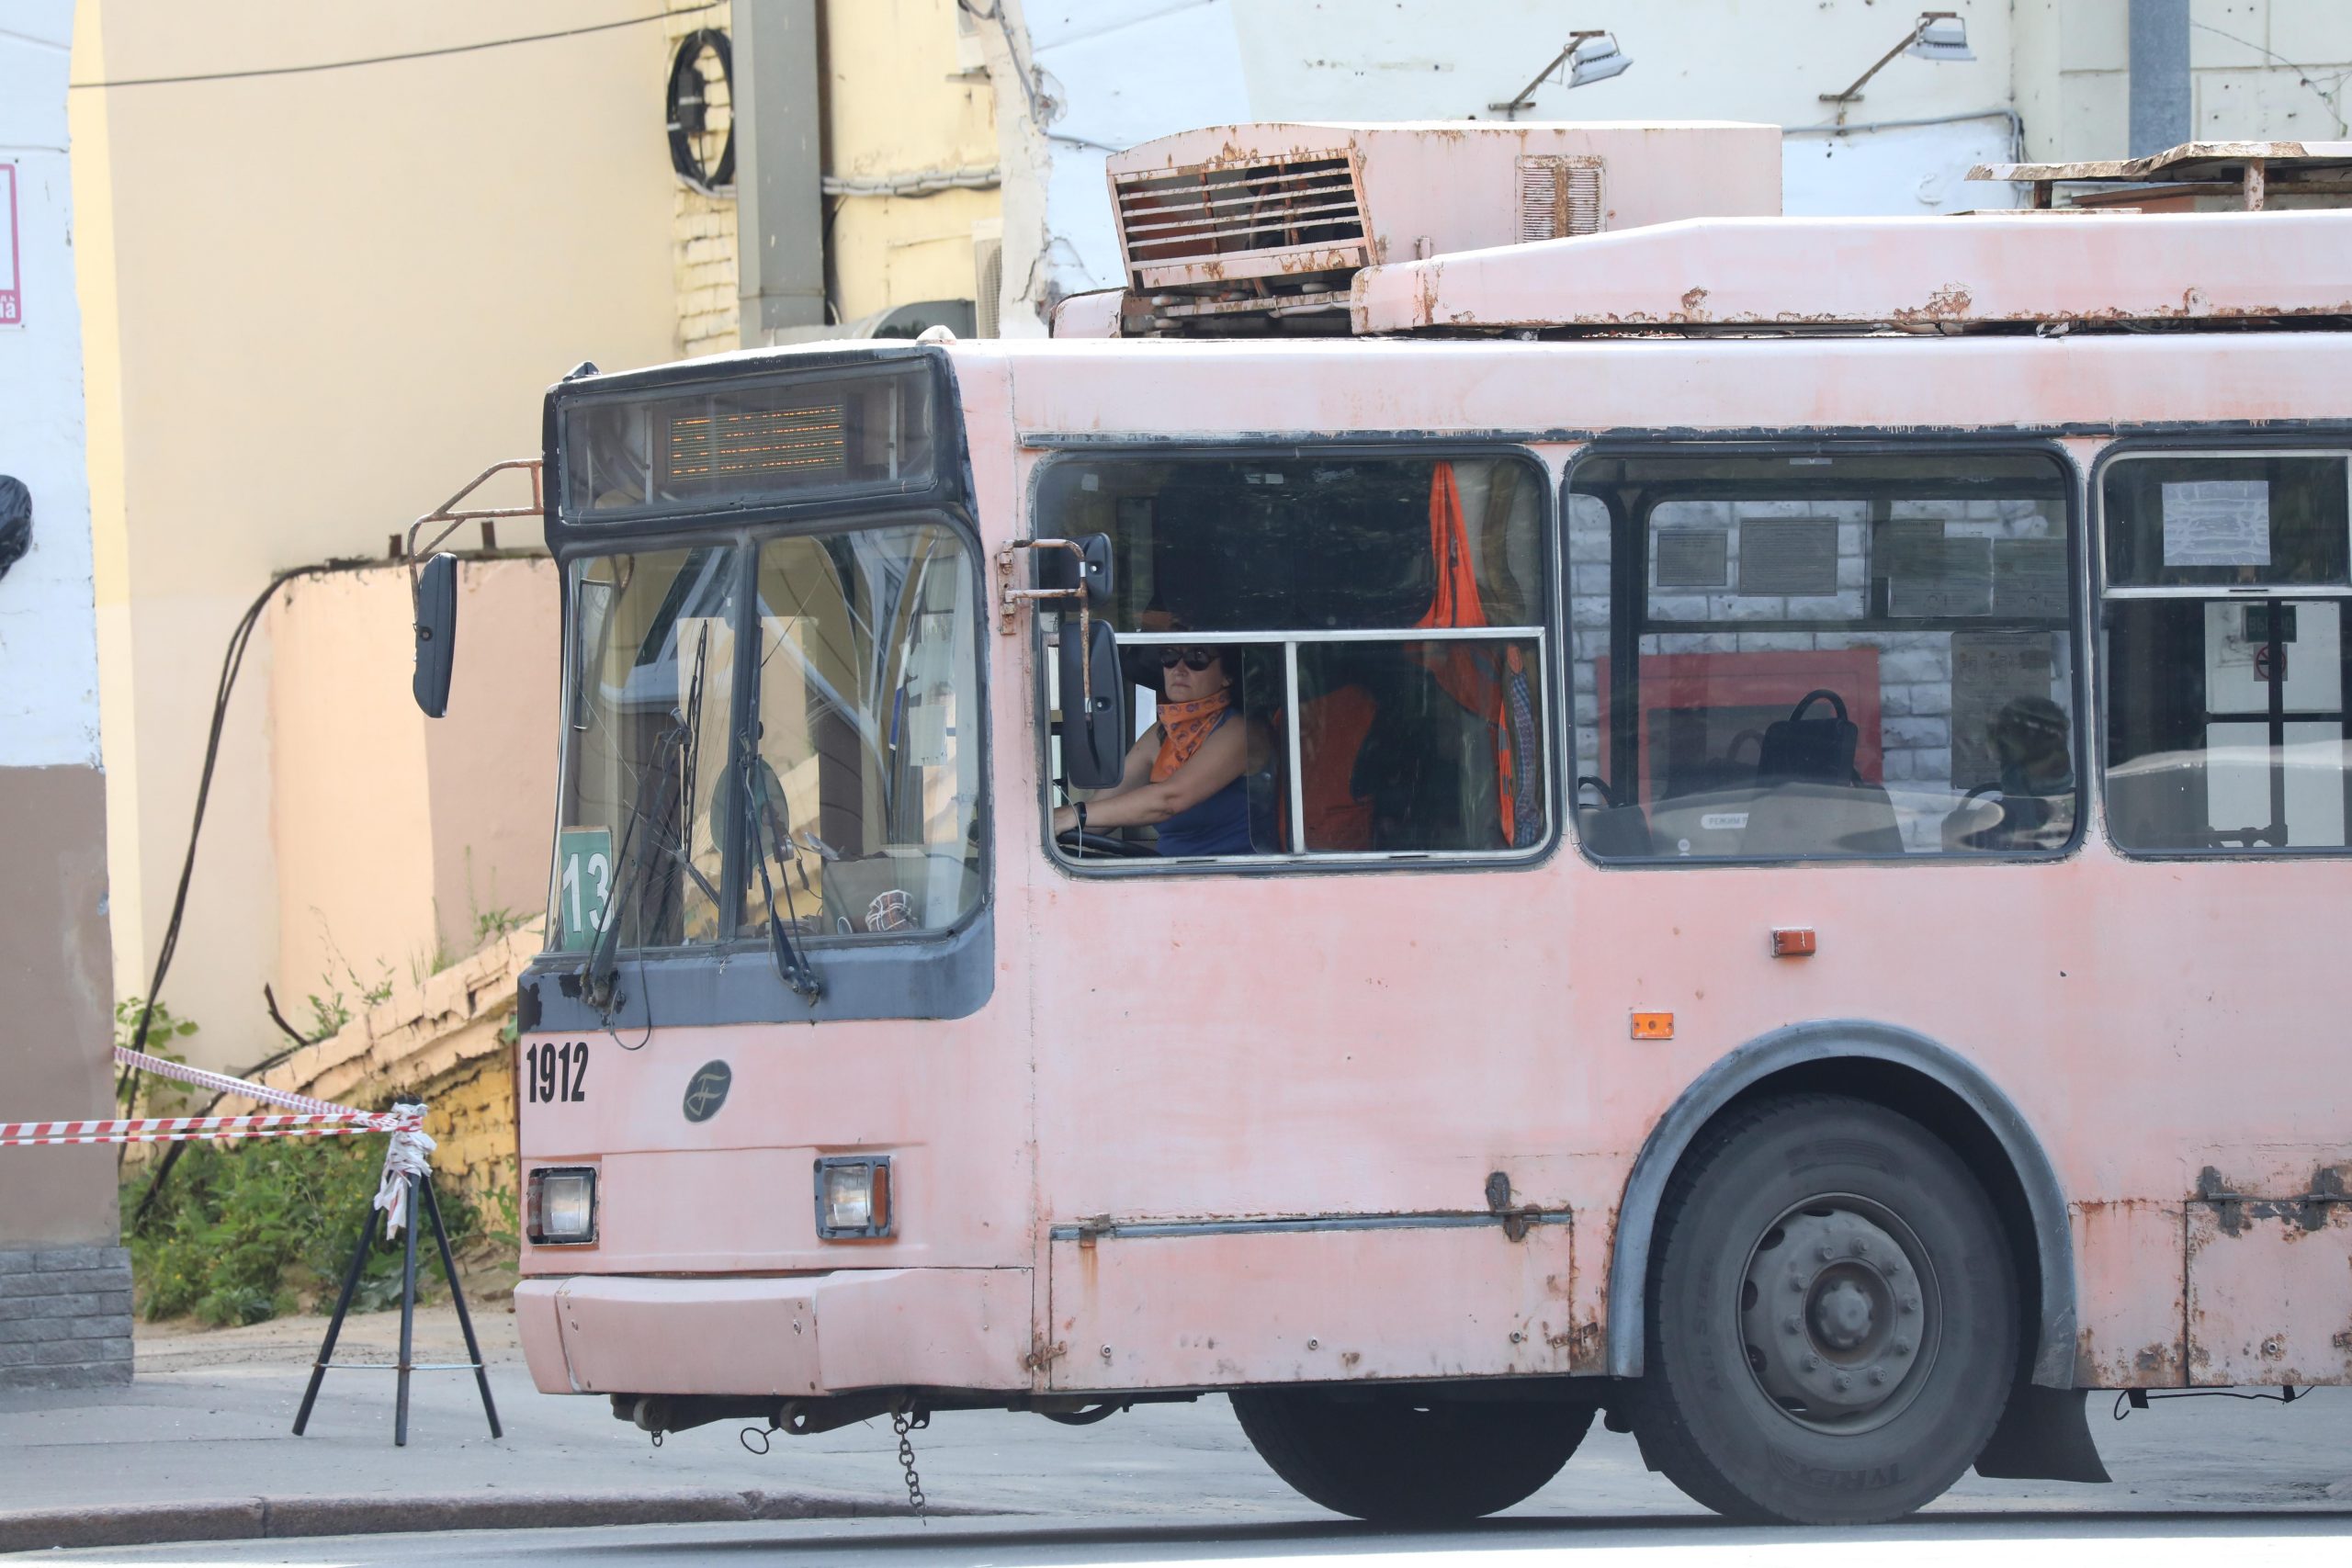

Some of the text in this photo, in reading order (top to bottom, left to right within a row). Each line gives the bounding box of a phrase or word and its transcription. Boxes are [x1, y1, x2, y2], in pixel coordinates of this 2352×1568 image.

[2248, 615, 2294, 635] ВЫД
[1709, 817, 1740, 825] РЕЖИМ
[562, 852, 613, 933] 13
[526, 1042, 589, 1103] 1912
